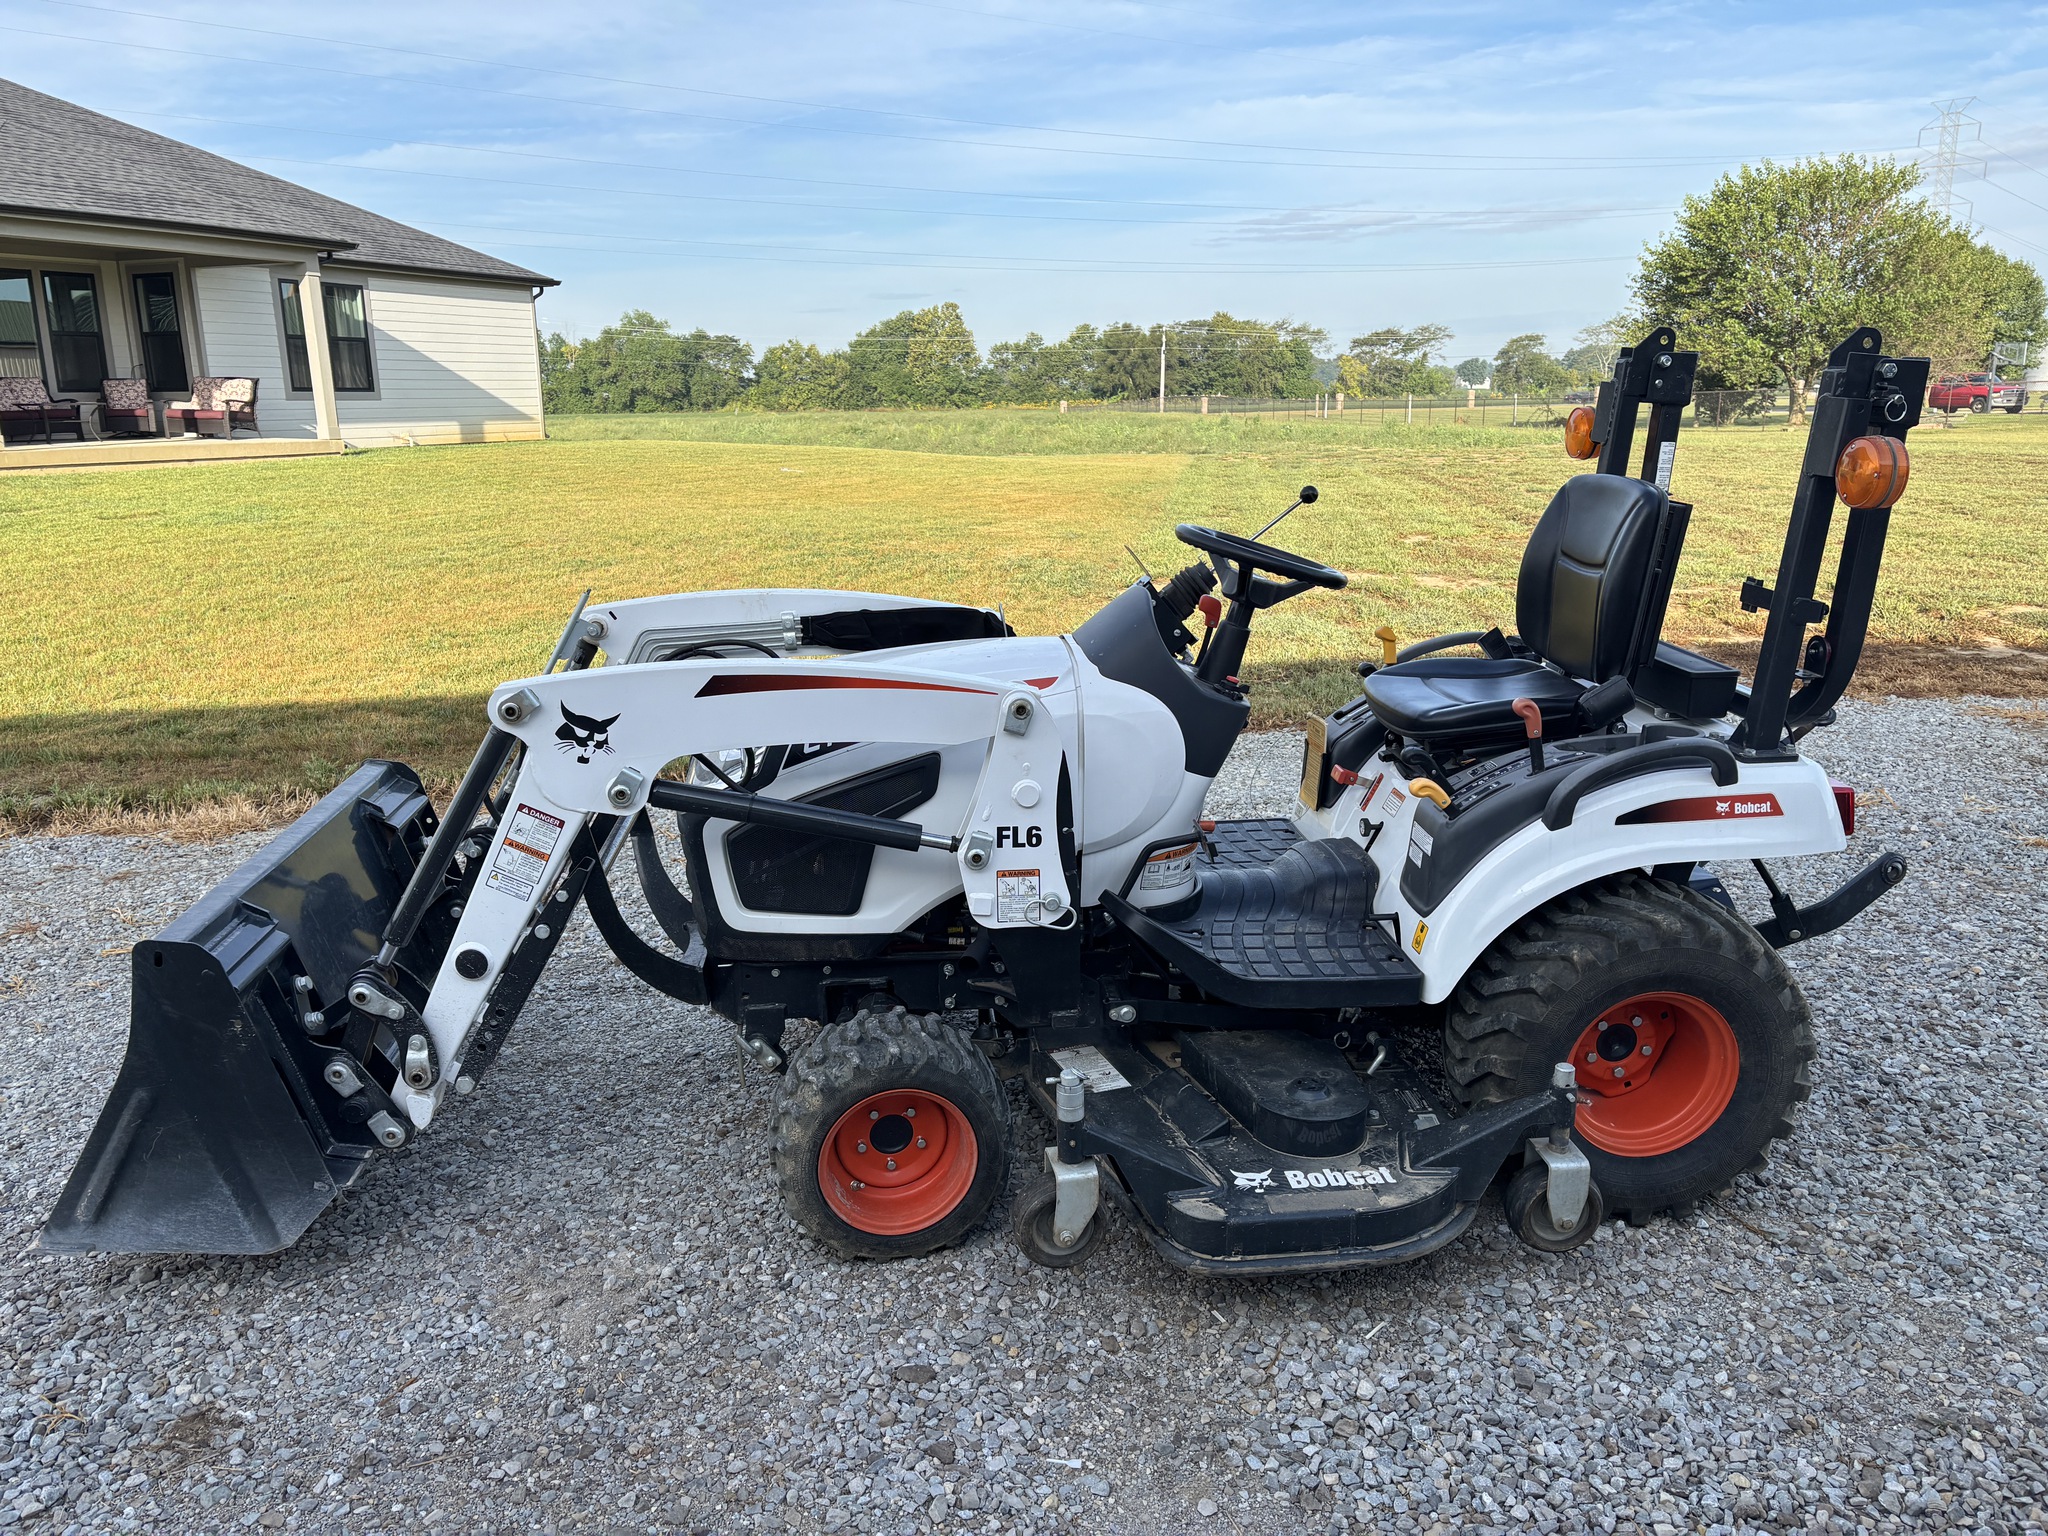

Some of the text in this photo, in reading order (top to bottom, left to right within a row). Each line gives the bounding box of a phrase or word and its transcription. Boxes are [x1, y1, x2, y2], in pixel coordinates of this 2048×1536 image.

[1734, 801, 1771, 814] Bobcat
[530, 809, 560, 827] DANGER
[996, 825, 1043, 849] FL6
[513, 842, 546, 860] WARNING
[1283, 1166, 1398, 1190] Bobcat
